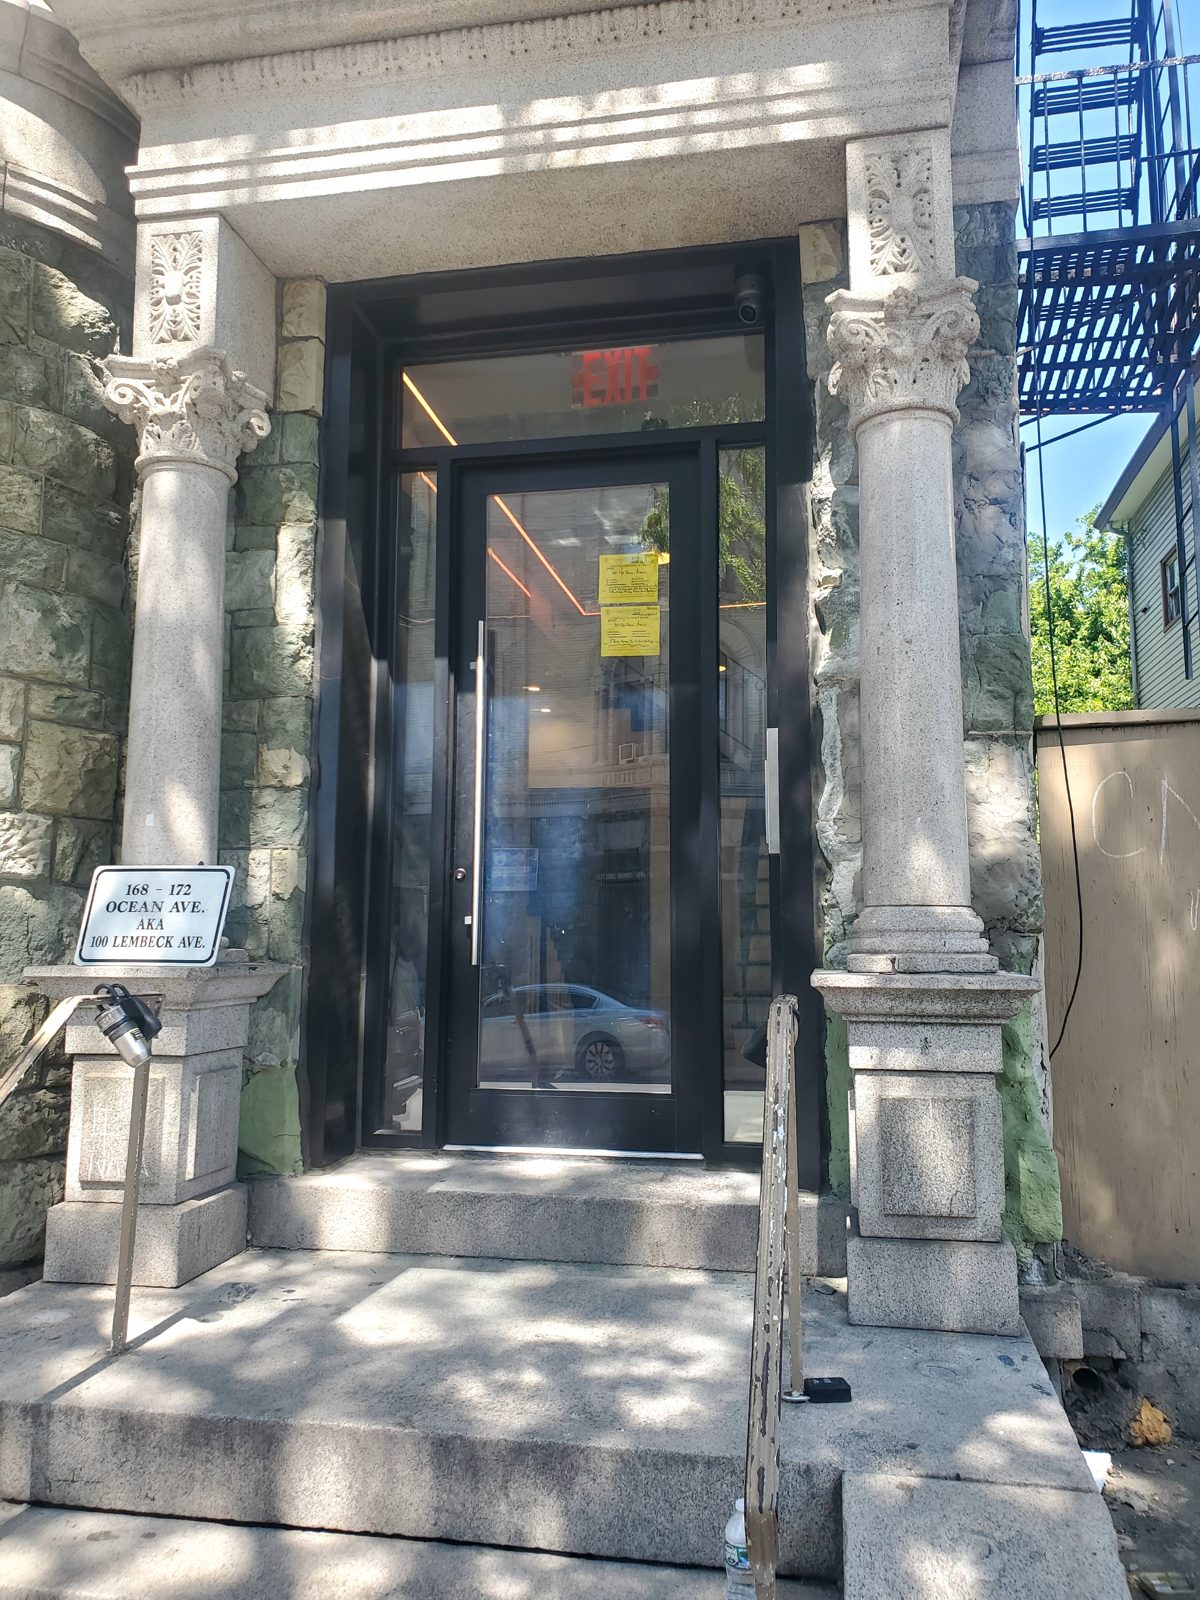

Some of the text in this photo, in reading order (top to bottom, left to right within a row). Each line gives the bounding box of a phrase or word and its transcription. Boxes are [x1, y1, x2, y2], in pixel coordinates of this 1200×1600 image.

[583, 346, 653, 408] EXIT
[125, 883, 149, 896] 168
[168, 883, 192, 896] 172
[106, 900, 206, 913] OCEAN AVE.
[136, 918, 165, 930] AKA
[90, 935, 206, 949] 100 LEMBECK AVE.
